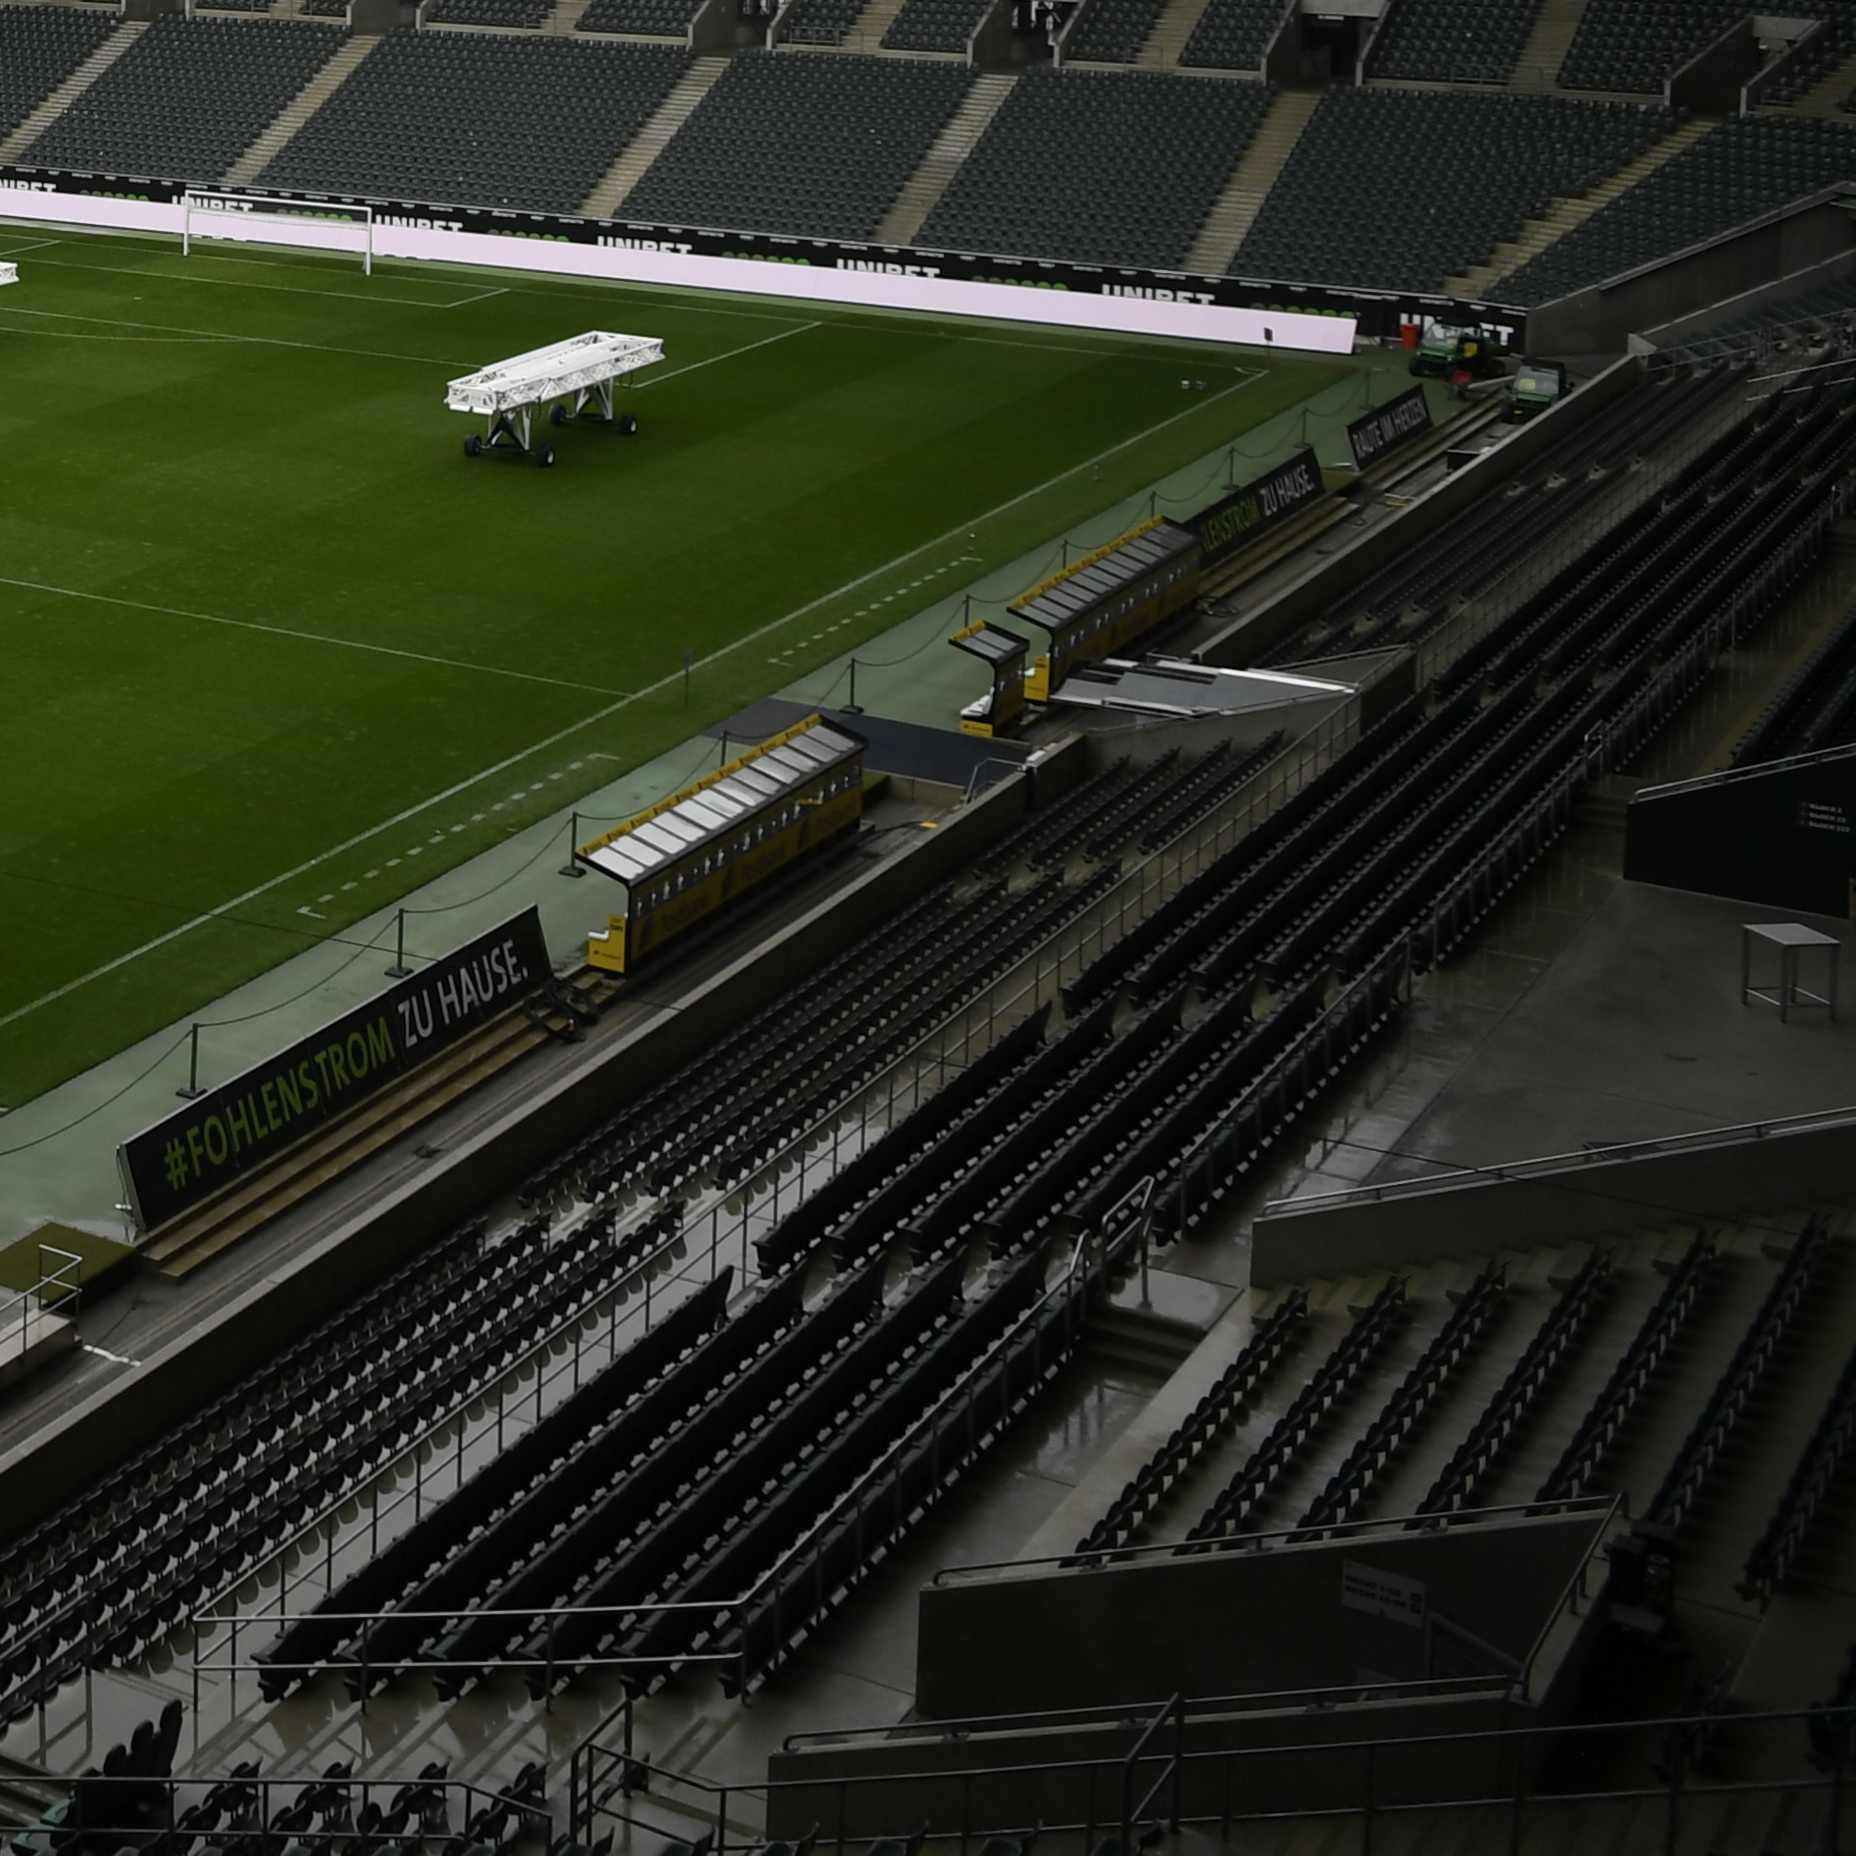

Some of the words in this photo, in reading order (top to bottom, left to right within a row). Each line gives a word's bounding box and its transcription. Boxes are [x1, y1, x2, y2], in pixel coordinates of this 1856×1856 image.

[161, 1015, 396, 1193] #FOHLENSTROM
[395, 997, 440, 1048] ZU
[438, 938, 530, 1028] HAUSE.
